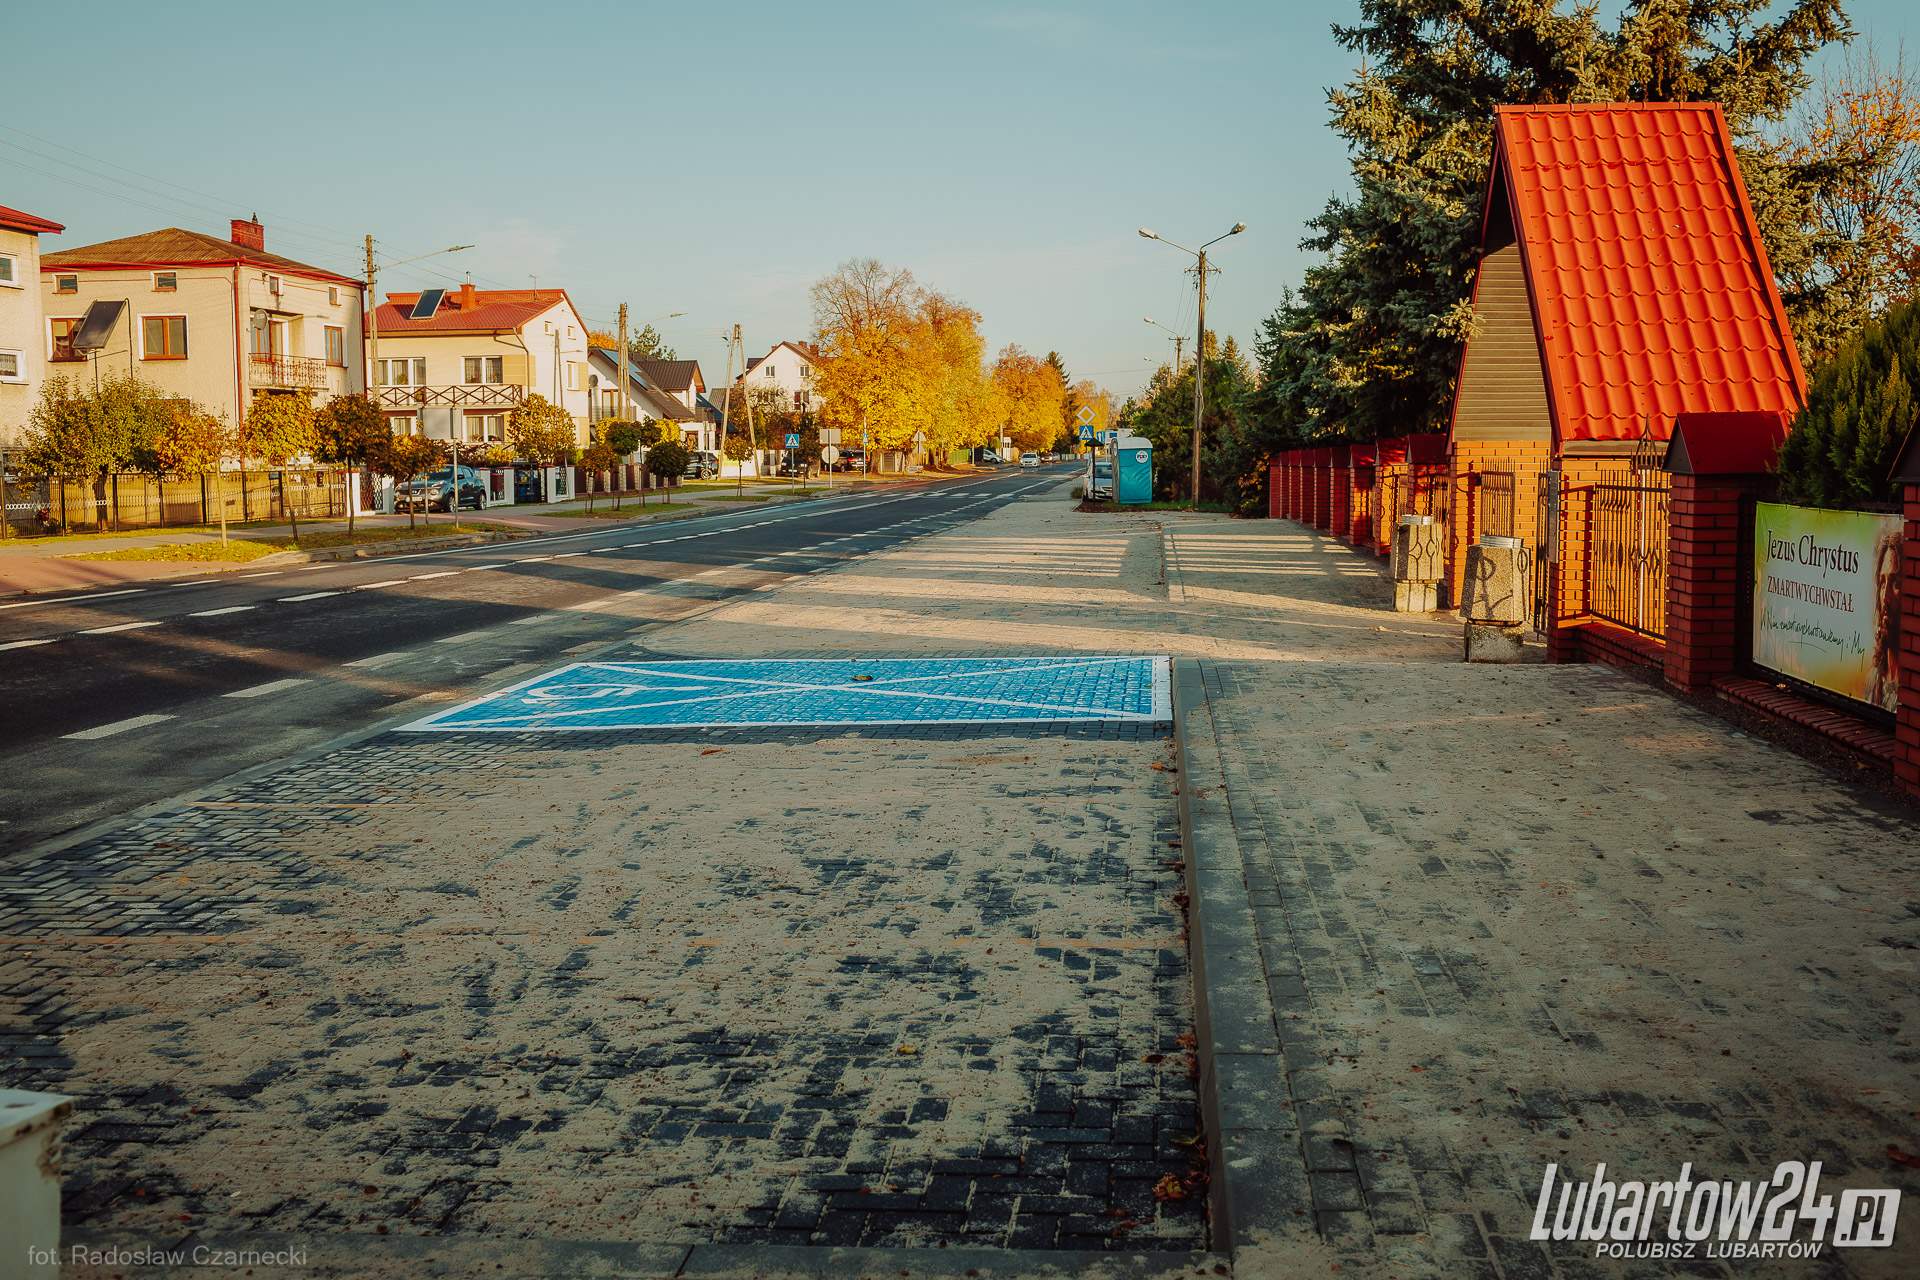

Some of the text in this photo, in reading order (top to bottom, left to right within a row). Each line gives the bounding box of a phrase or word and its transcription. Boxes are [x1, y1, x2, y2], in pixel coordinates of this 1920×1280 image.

[1766, 529, 1859, 578] Jezus Chrystus
[1767, 575, 1855, 613] ZMARTWYCHWSTAŁ
